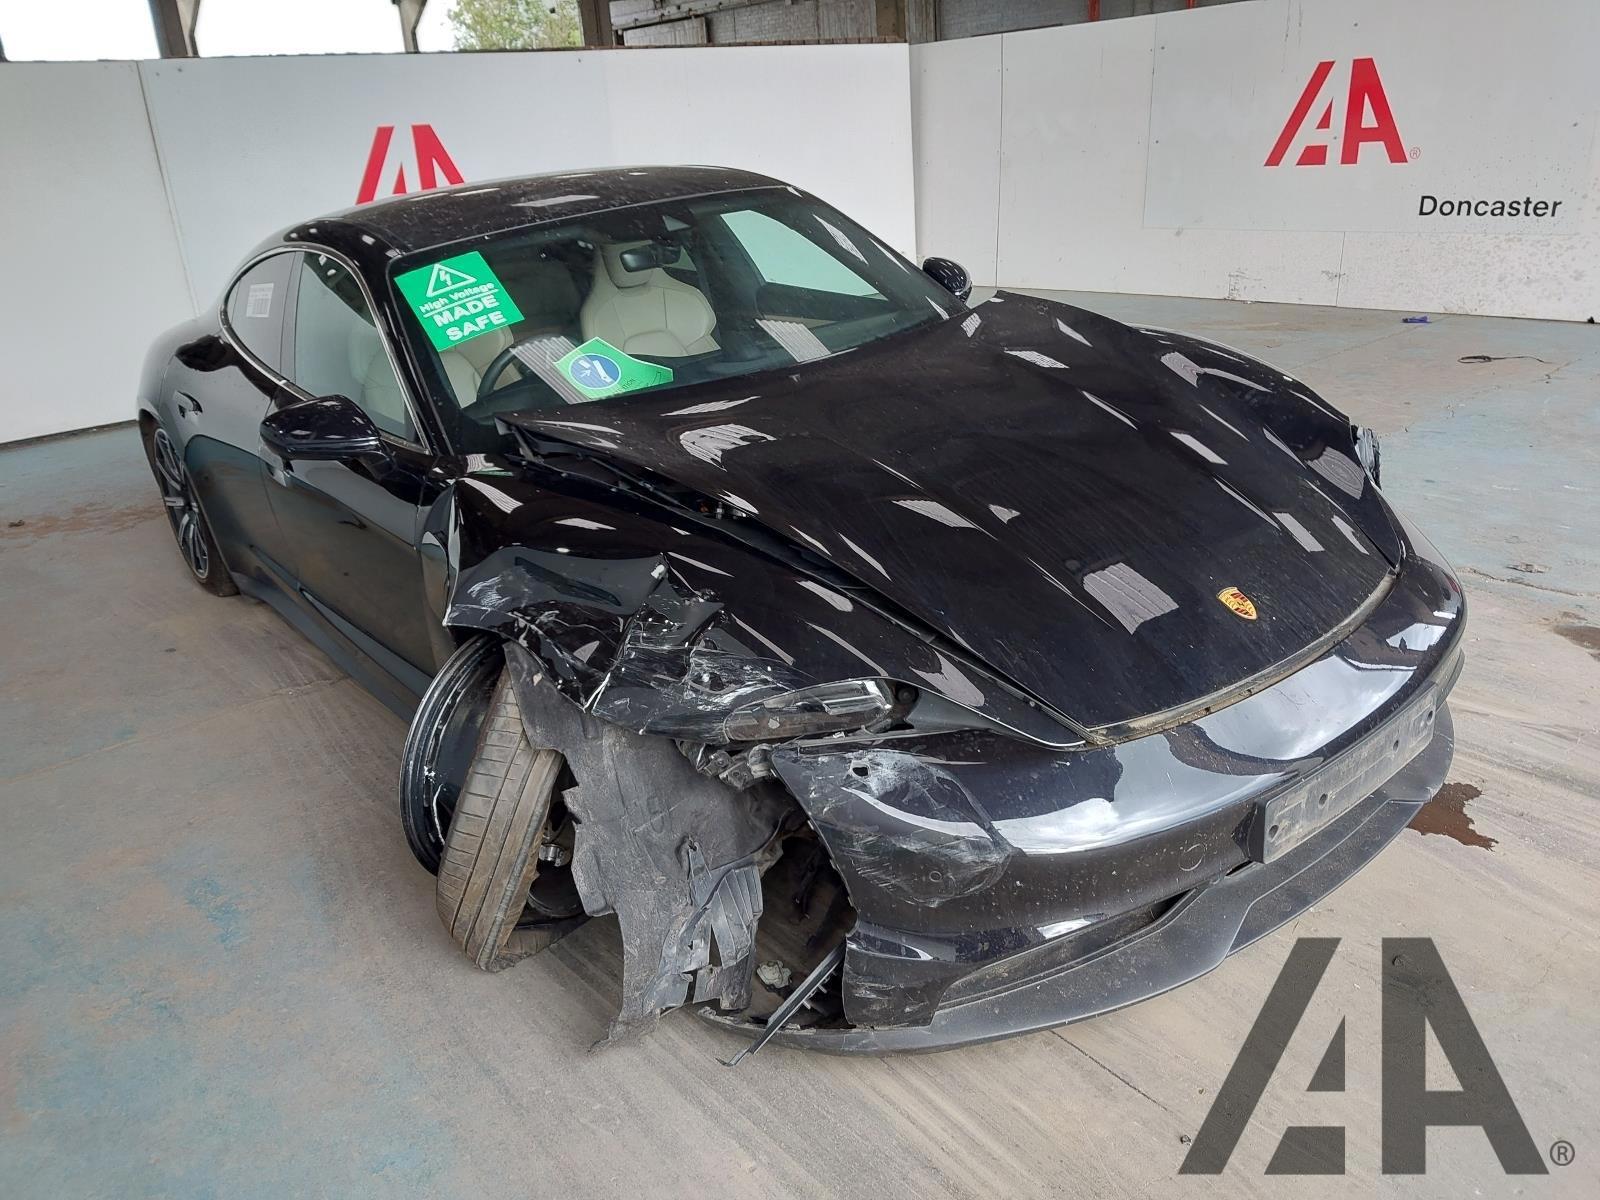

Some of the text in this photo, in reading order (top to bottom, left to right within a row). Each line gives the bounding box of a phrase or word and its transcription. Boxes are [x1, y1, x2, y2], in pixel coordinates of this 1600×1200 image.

[1418, 195, 1563, 217] Doncaster
[419, 282, 495, 314] High Voltage
[432, 294, 500, 328] MADE
[446, 310, 508, 341] SAFE
